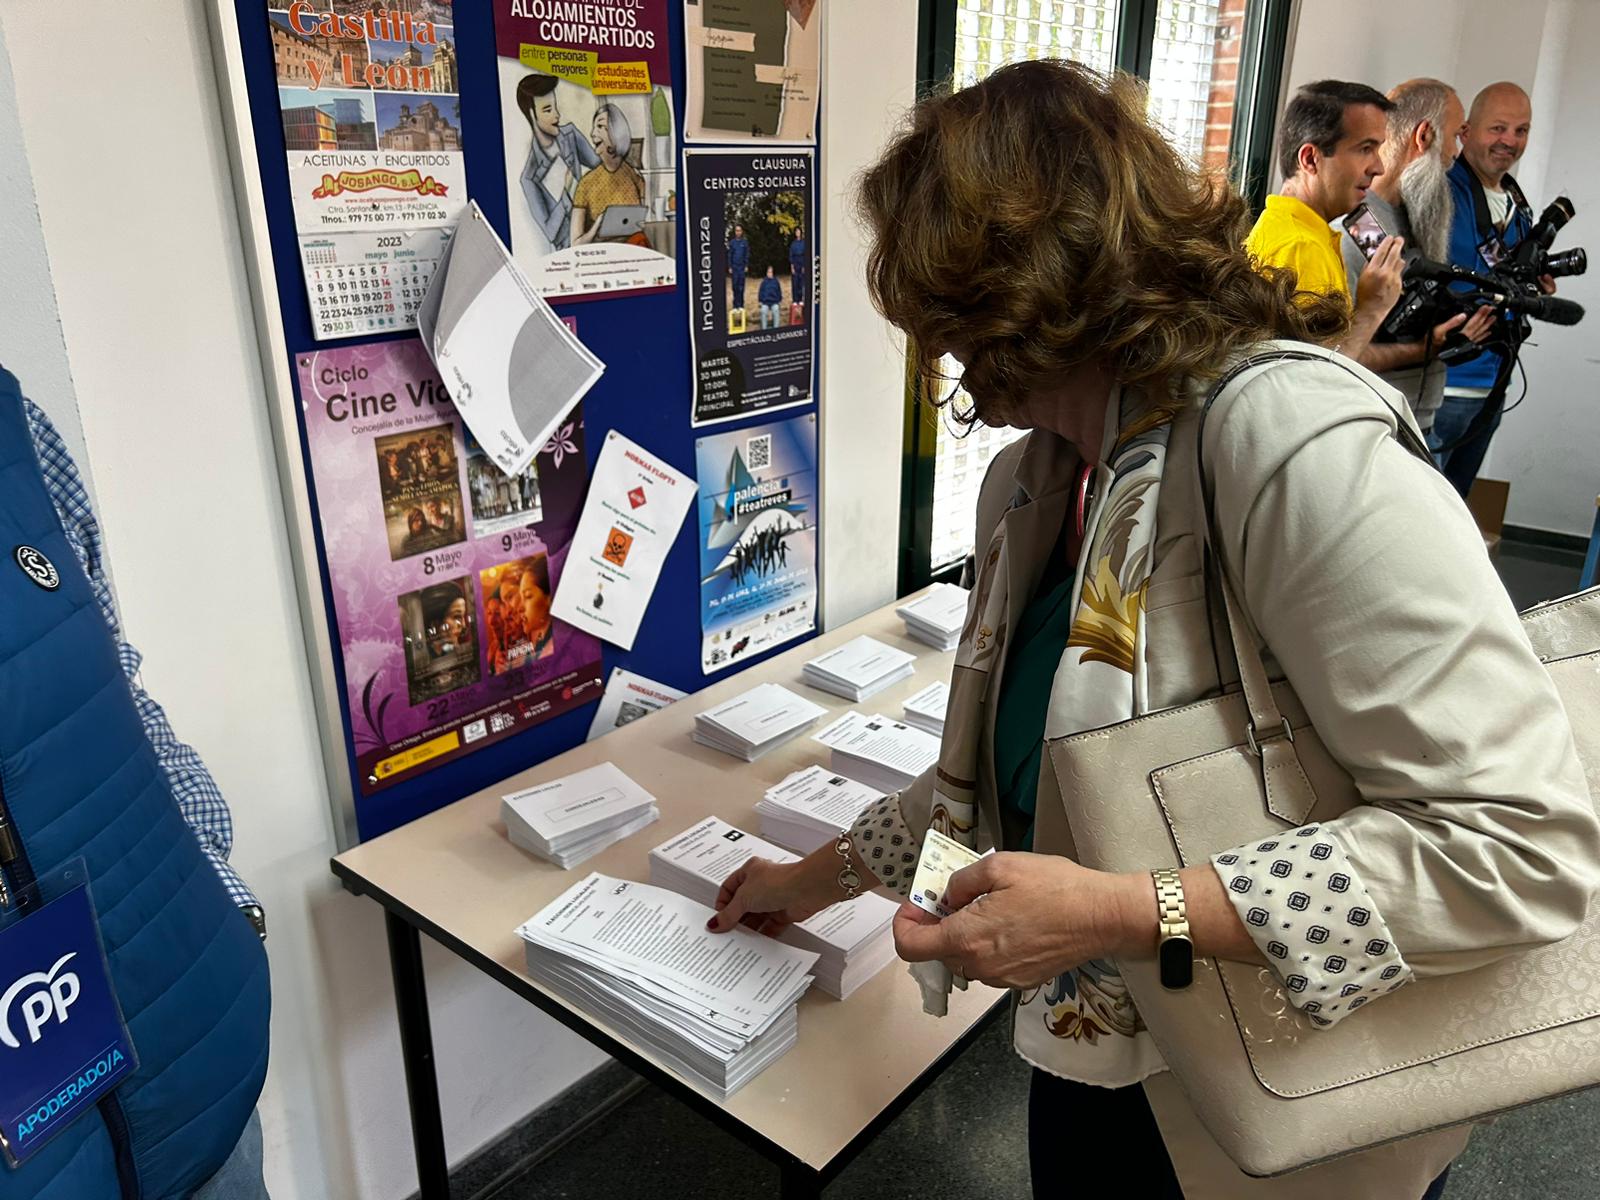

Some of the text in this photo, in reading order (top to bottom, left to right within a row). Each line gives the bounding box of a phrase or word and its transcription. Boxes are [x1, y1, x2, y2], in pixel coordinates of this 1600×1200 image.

[511, 0, 637, 28] ALOJAMIENTOS
[289, 1, 437, 45] Castilla
[540, 21, 656, 49] COMPARTIDOS
[521, 47, 588, 63] entre personas
[304, 53, 433, 92] y León
[551, 63, 588, 77] mayores
[597, 65, 646, 79] estudiantes
[592, 78, 648, 91] universitarios
[303, 155, 450, 167] ACEITUNAS Y ENCURTIDOS
[752, 158, 806, 170] CLAUSURA
[703, 176, 806, 190] CENTROS SOCIALES
[407, 202, 438, 211] PALENCIA
[349, 214, 362, 223] 979
[364, 214, 373, 222] 75
[375, 213, 384, 222] 00
[386, 213, 394, 221] 77
[402, 212, 415, 221] 979
[417, 212, 425, 220] 17
[427, 212, 436, 220] 02
[438, 211, 447, 219] 30
[377, 237, 402, 248] 2023
[365, 250, 415, 260] mayo junio
[315, 266, 387, 279] 1 2 3 4 5 6 7
[699, 216, 714, 331] Includanza
[317, 279, 391, 293] 8 9 10 11 12 13 14
[318, 291, 392, 306] 15 16 17 18 19 20 21
[402, 289, 411, 298] 12
[321, 304, 395, 319] 22 23 24 25 26 27 28
[322, 323, 333, 332] 29
[321, 365, 369, 385] Ciclo
[710, 367, 731, 379] MAYO
[703, 391, 729, 402] TEATRO
[326, 391, 397, 422] Cine
[698, 400, 735, 412] PRINCIPAL
[352, 420, 393, 435] Concejalía
[394, 419, 405, 427] de
[406, 417, 413, 425] la
[415, 413, 436, 424] Mujer
[502, 530, 536, 552] 9 Mayo
[423, 551, 462, 575] 8 Mayo
[427, 699, 449, 720] 22
[613, 882, 629, 895] VOX
[17, 1049, 124, 1141] APODERADO/A
